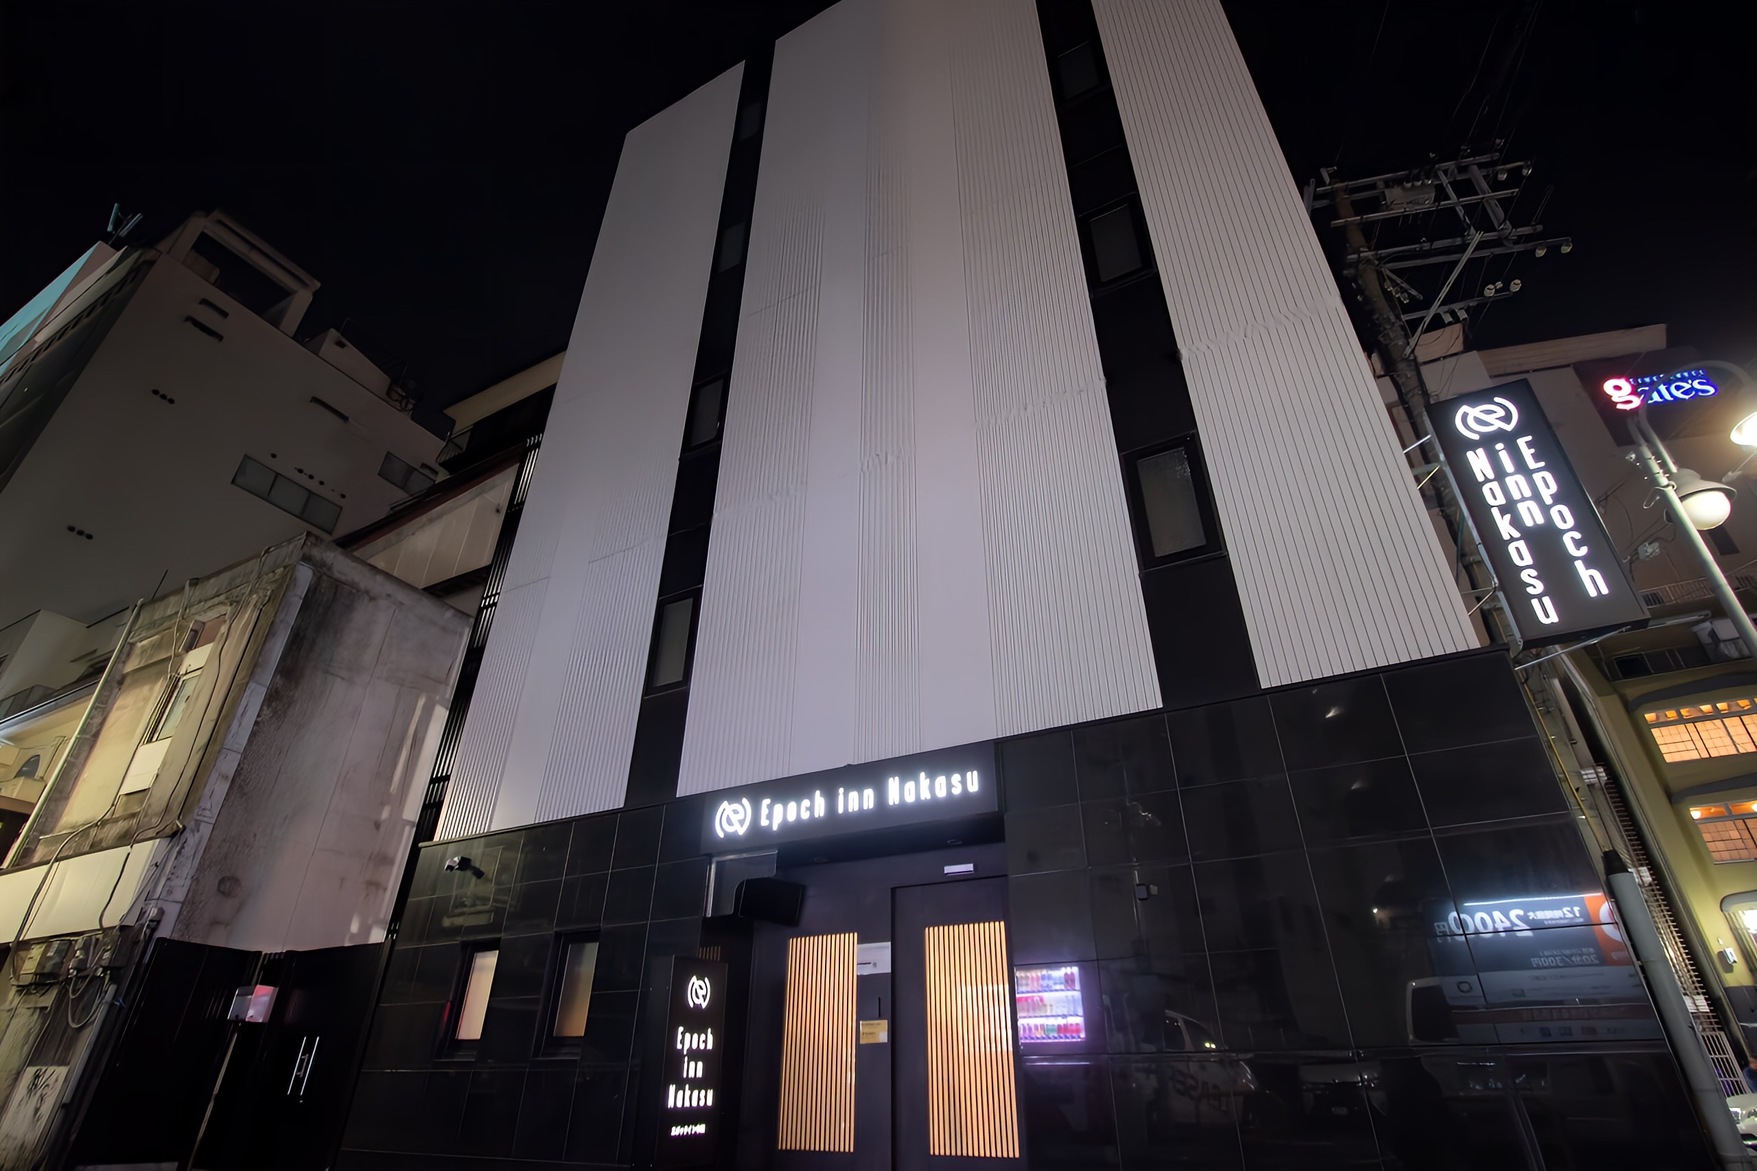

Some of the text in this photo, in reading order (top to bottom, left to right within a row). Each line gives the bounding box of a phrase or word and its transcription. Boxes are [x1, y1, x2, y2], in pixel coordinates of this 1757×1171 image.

[1494, 442, 1545, 527] inn
[1465, 447, 1559, 625] Nakasu
[1516, 435, 1610, 598] Epoch
[759, 769, 980, 831] Epoch inn Nakasu
[676, 1025, 714, 1055] Epoch
[682, 1055, 704, 1079] inn
[667, 1083, 714, 1109] Nakasu
